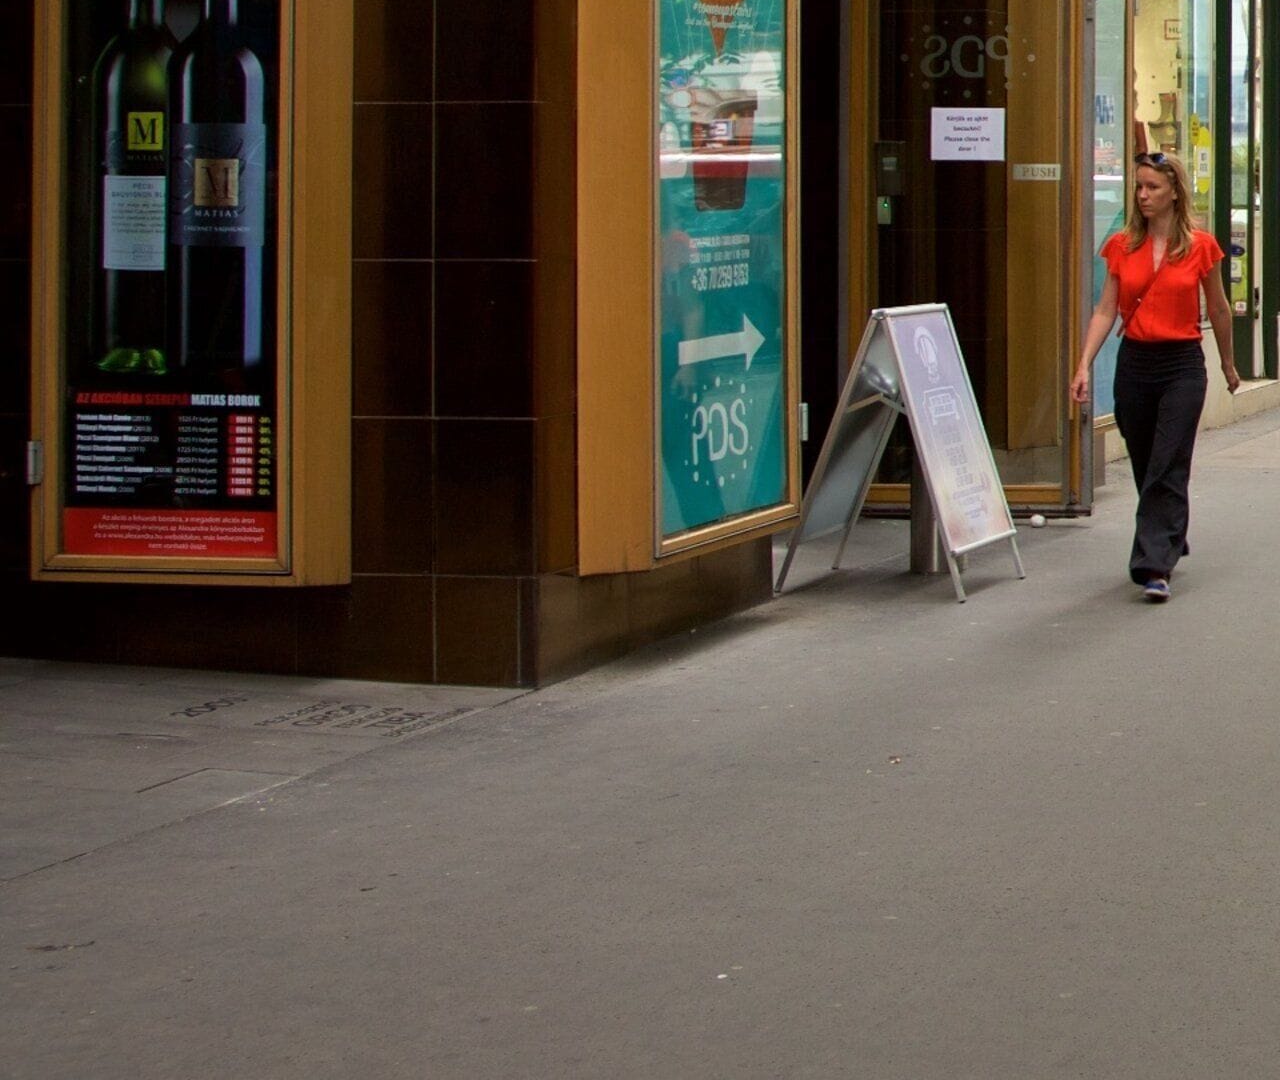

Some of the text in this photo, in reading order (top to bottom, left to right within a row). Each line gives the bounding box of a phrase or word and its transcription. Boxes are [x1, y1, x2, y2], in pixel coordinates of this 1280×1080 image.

[131, 118, 159, 145] M
[1021, 167, 1057, 177] PUSH
[191, 394, 226, 406] MATIAS
[228, 394, 260, 407] BOROK
[692, 398, 749, 465] PDS
